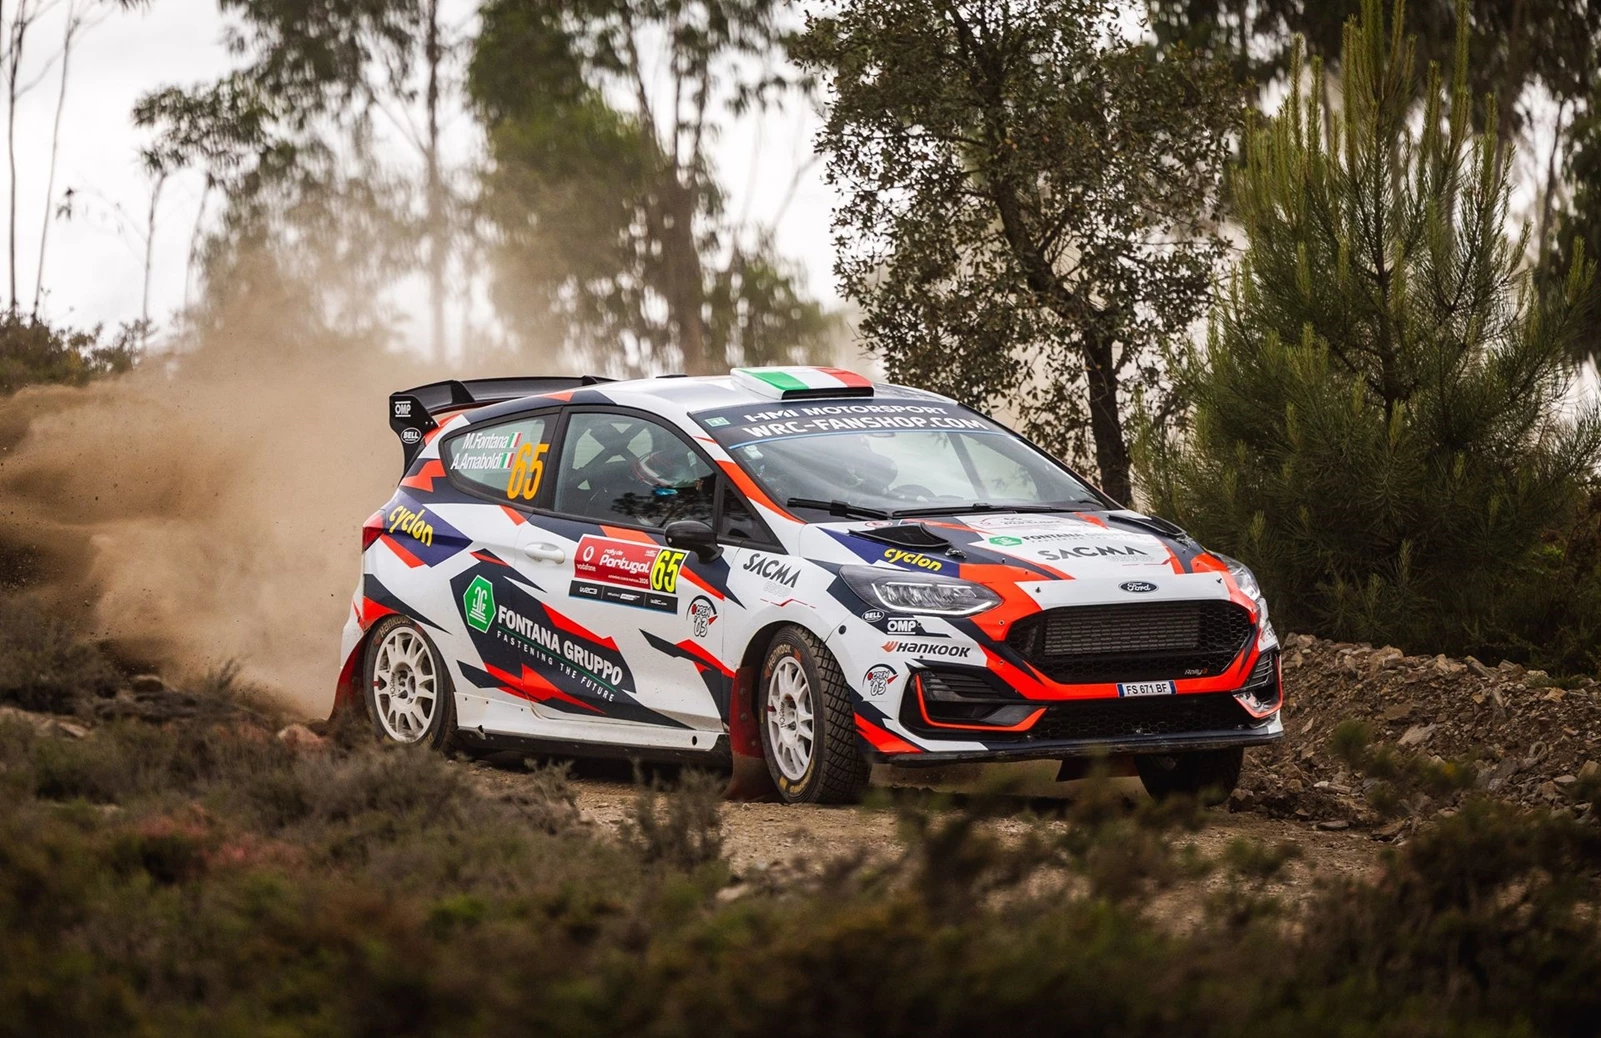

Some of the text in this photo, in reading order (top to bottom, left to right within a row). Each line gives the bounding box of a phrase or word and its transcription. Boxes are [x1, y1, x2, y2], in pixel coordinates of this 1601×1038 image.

[395, 404, 411, 415] OMP
[744, 409, 800, 422] HMI
[801, 404, 948, 417] MOTORSPORT
[403, 431, 419, 439] BELL
[741, 416, 989, 438] WRC-FANSHOP.COM
[507, 443, 549, 500] 65
[389, 505, 433, 547] cyclon
[884, 548, 942, 571] cyclon
[1037, 545, 1148, 561] SACMA
[576, 563, 596, 572] vodafone
[599, 554, 650, 574] Portugal
[652, 550, 684, 593] 65
[743, 553, 802, 588] SACMA
[1127, 582, 1151, 592] Ford
[864, 611, 881, 619] BELL
[887, 620, 916, 632] OMP
[498, 605, 623, 686] FONTANA GRUPPO
[497, 630, 615, 702] FASTENING THE FUTURE
[1126, 683, 1167, 695] FS 671 BF
